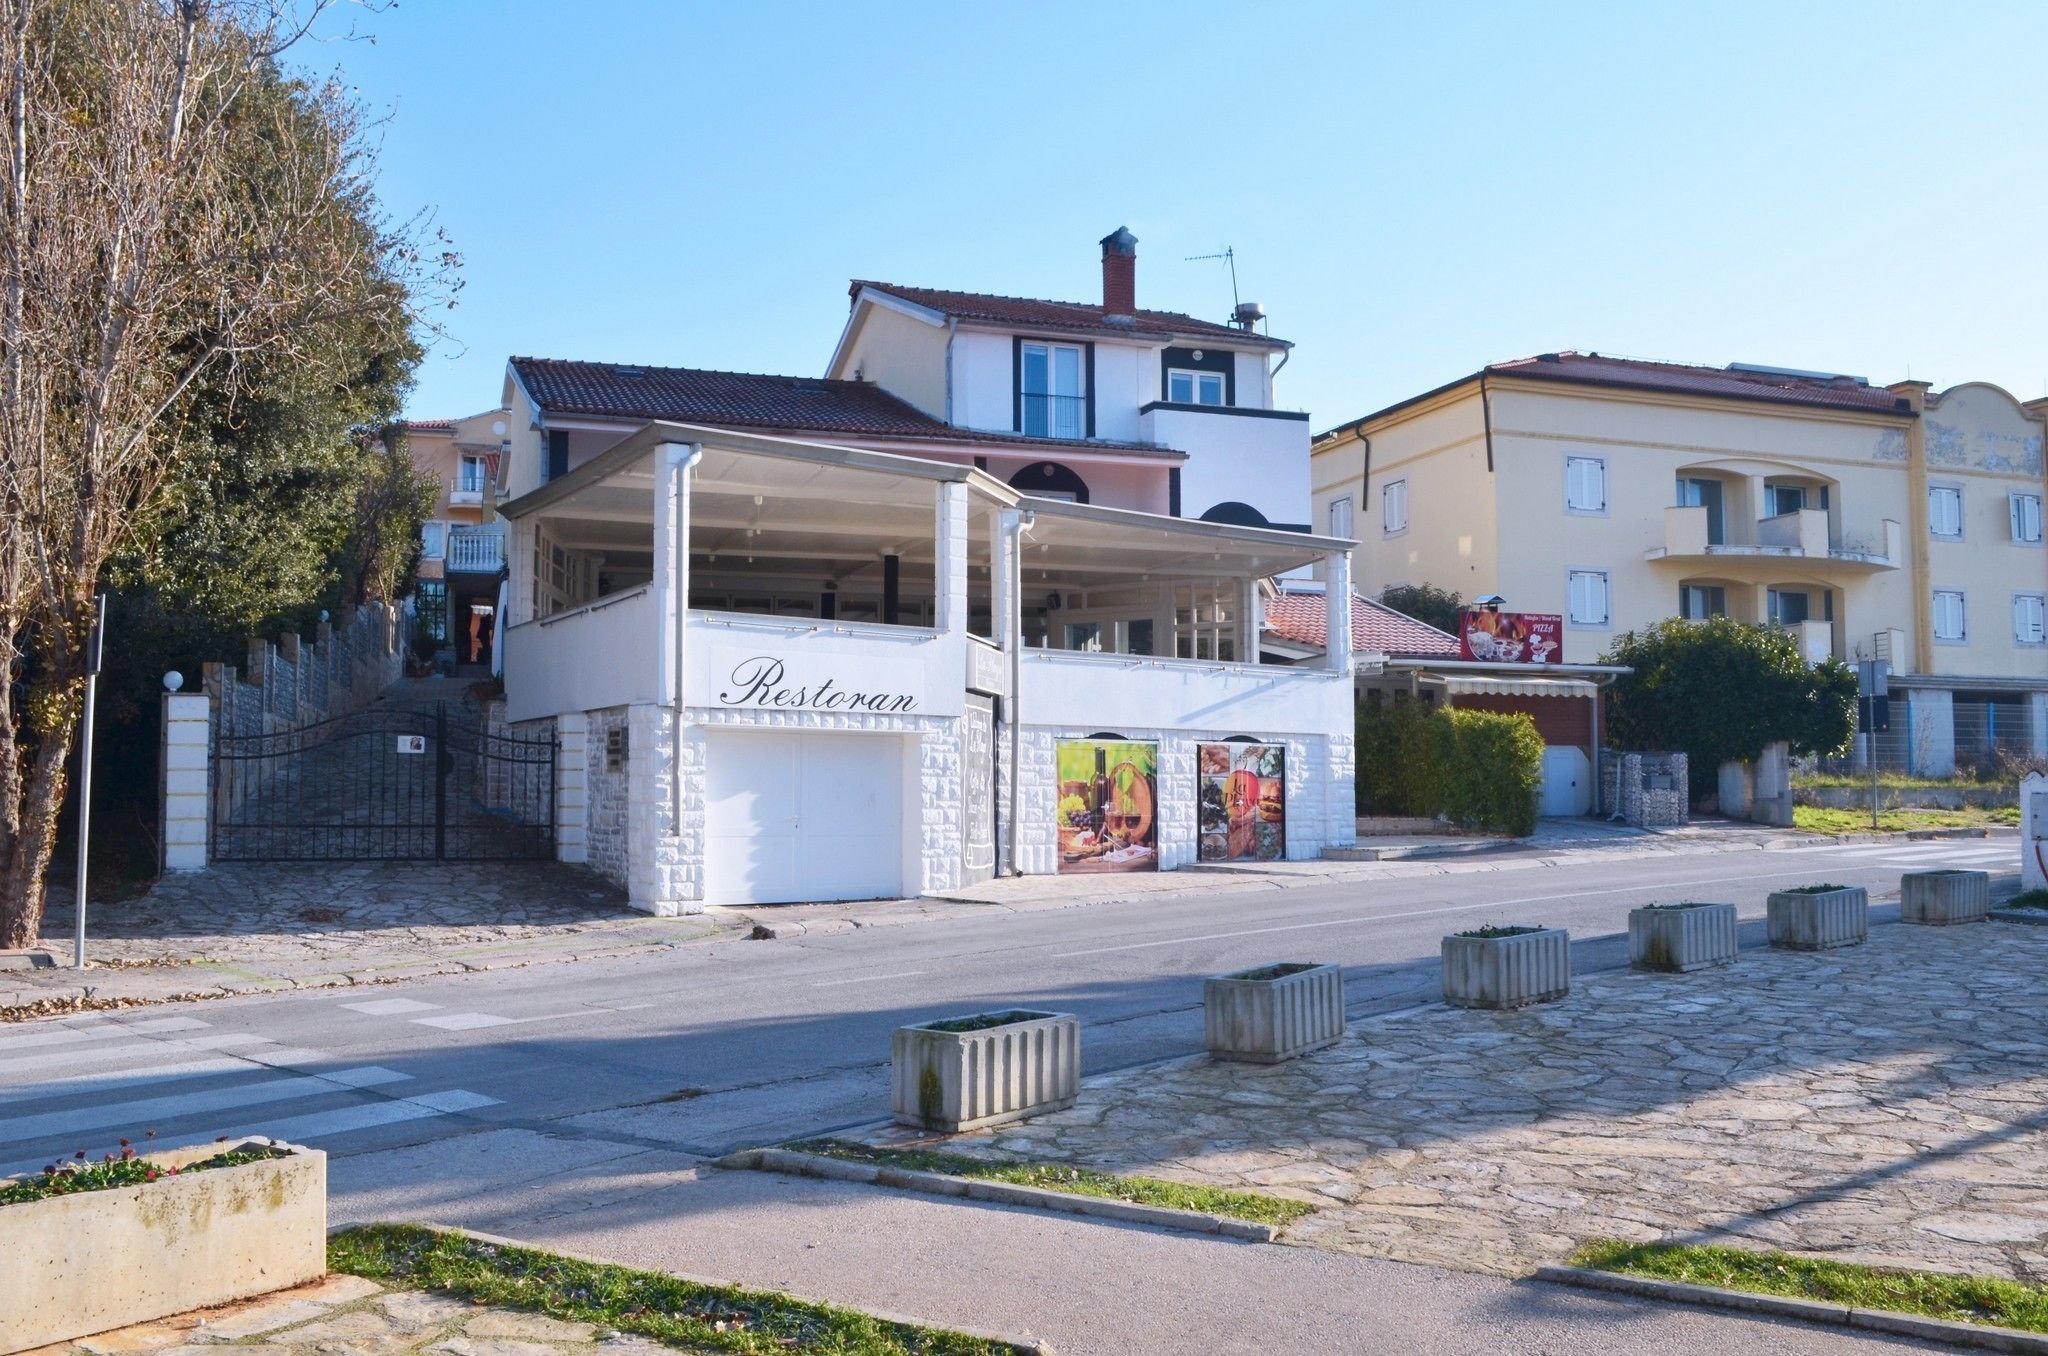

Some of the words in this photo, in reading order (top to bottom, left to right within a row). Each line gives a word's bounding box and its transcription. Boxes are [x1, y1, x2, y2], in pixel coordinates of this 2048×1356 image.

[1532, 623, 1554, 633] PIZZA
[719, 656, 919, 712] Restoran
[1232, 778, 1247, 796] La
[1224, 792, 1260, 812] Plya
